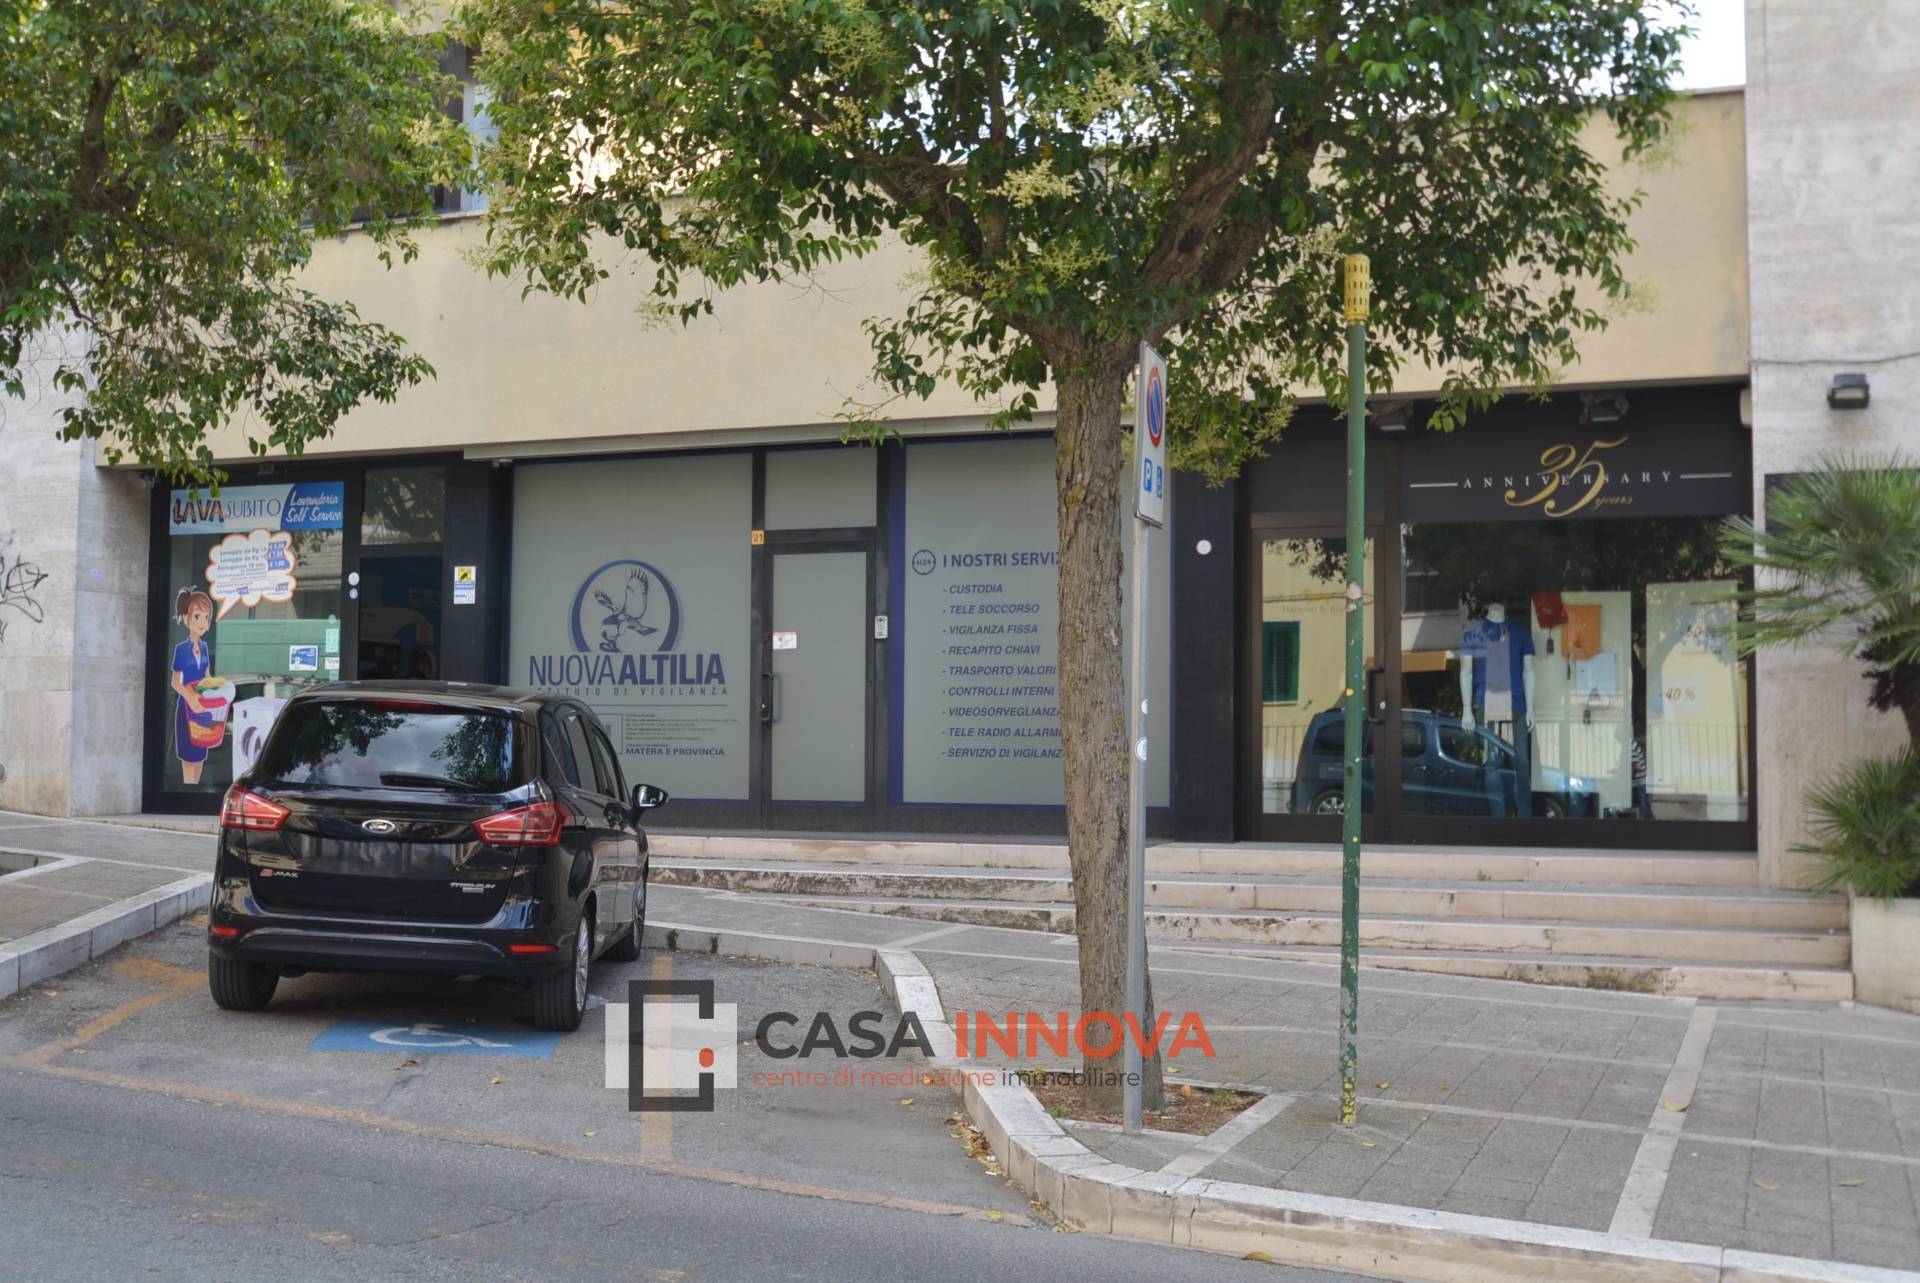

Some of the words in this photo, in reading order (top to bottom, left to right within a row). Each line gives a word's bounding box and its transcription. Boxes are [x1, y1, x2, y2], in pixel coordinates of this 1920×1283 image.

[1505, 436, 1628, 517] 35
[290, 491, 339, 506] Lavanderia
[286, 507, 309, 523] Self
[309, 507, 342, 522] Service
[943, 555, 947, 567] I
[952, 553, 1007, 567] NOSTRI
[949, 584, 1003, 594] CUSTODIA
[950, 605, 975, 614] TELE
[977, 604, 1040, 614] SOCCORSO
[949, 625, 1004, 635] VIGILANZA
[1007, 624, 1038, 634] FISSA
[948, 645, 1002, 655] RECAPITO
[1004, 645, 1040, 655] CHIAVI
[949, 666, 1013, 676] TRASPORTO
[1017, 665, 1056, 675] VALORI
[614, 687, 627, 696] DI
[641, 687, 728, 696] VIGILANZA
[948, 687, 1009, 696] CONTROLLI
[1012, 687, 1055, 696] INTERNI
[949, 728, 975, 737] TELE
[977, 728, 1011, 737] RADIO
[625, 748, 663, 756] MATERA
[665, 748, 671, 756] E
[673, 748, 725, 756] PROVINCIA
[947, 748, 997, 758] SERVIZIO
[999, 749, 1010, 758] DI
[1013, 748, 1063, 758] VIGILANZ
